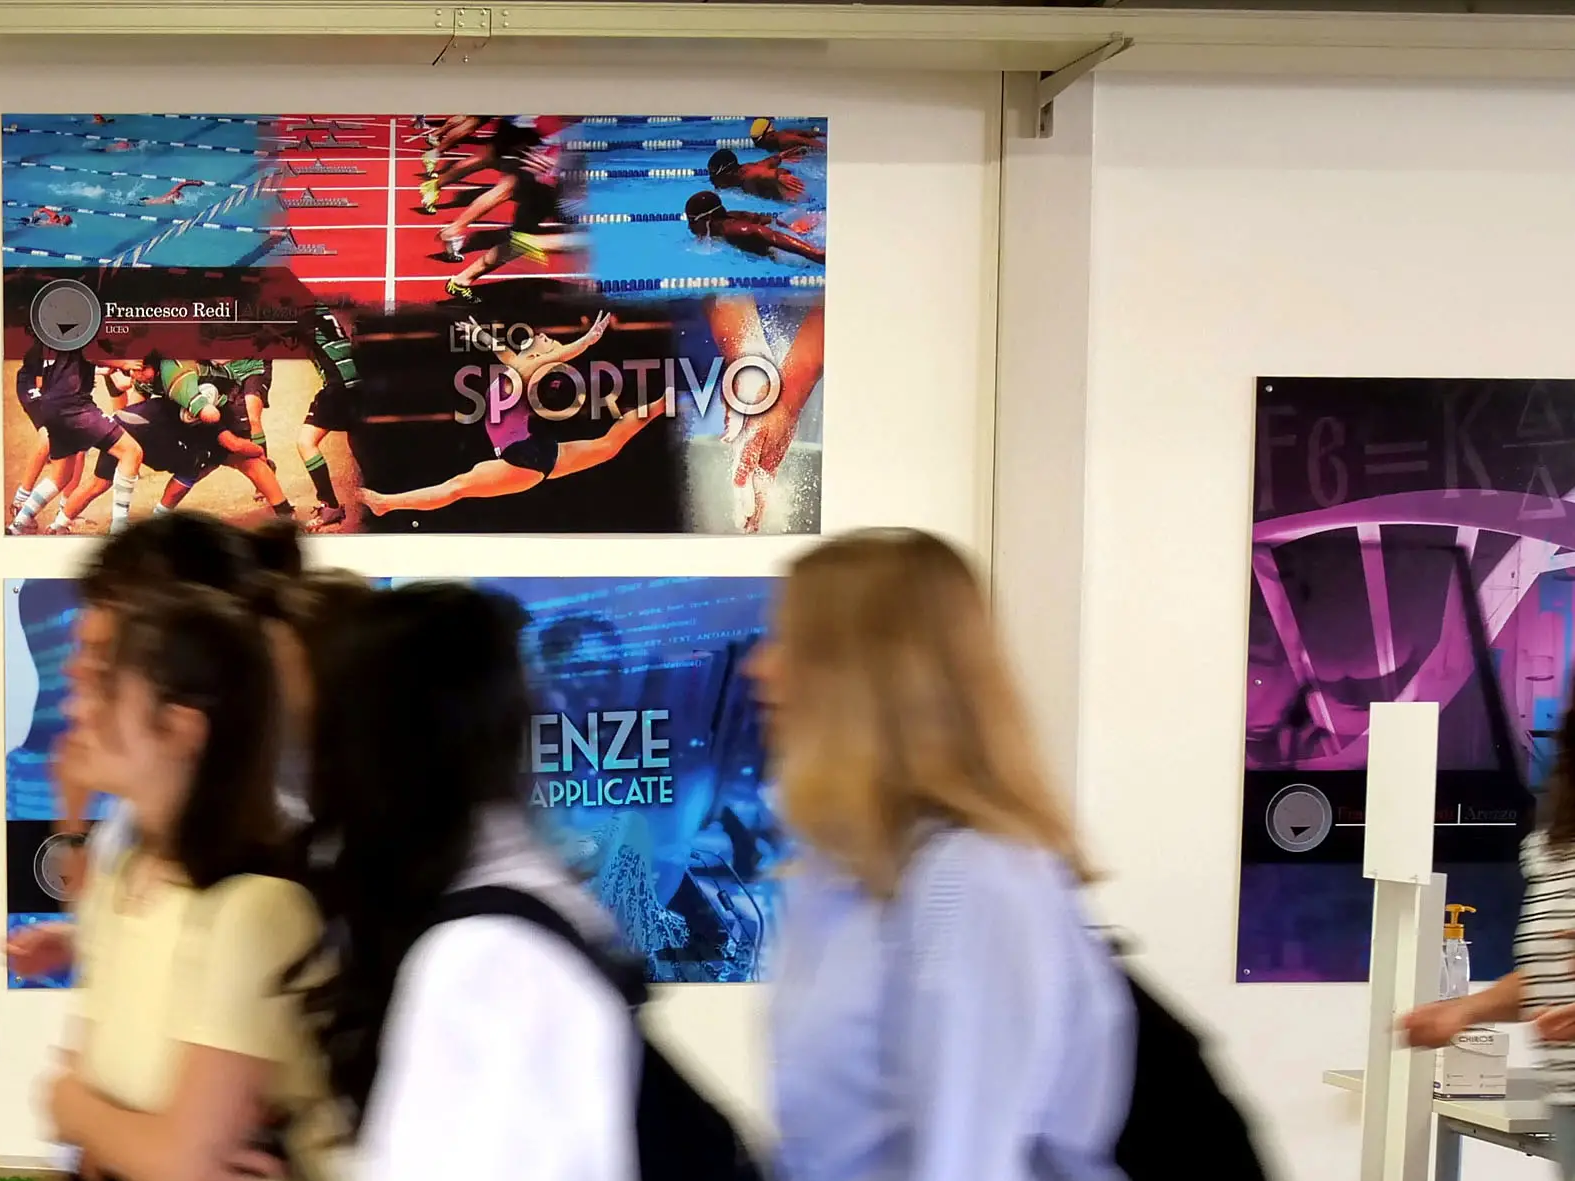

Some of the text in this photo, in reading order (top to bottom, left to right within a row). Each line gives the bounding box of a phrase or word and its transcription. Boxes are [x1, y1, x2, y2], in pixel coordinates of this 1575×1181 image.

[105, 302, 188, 318] Francesco
[192, 301, 231, 318] Redi
[105, 325, 129, 334] LICEO
[448, 323, 534, 352] LICEO
[453, 355, 782, 425] SPORTIVO
[530, 776, 673, 808] APPLICATE
